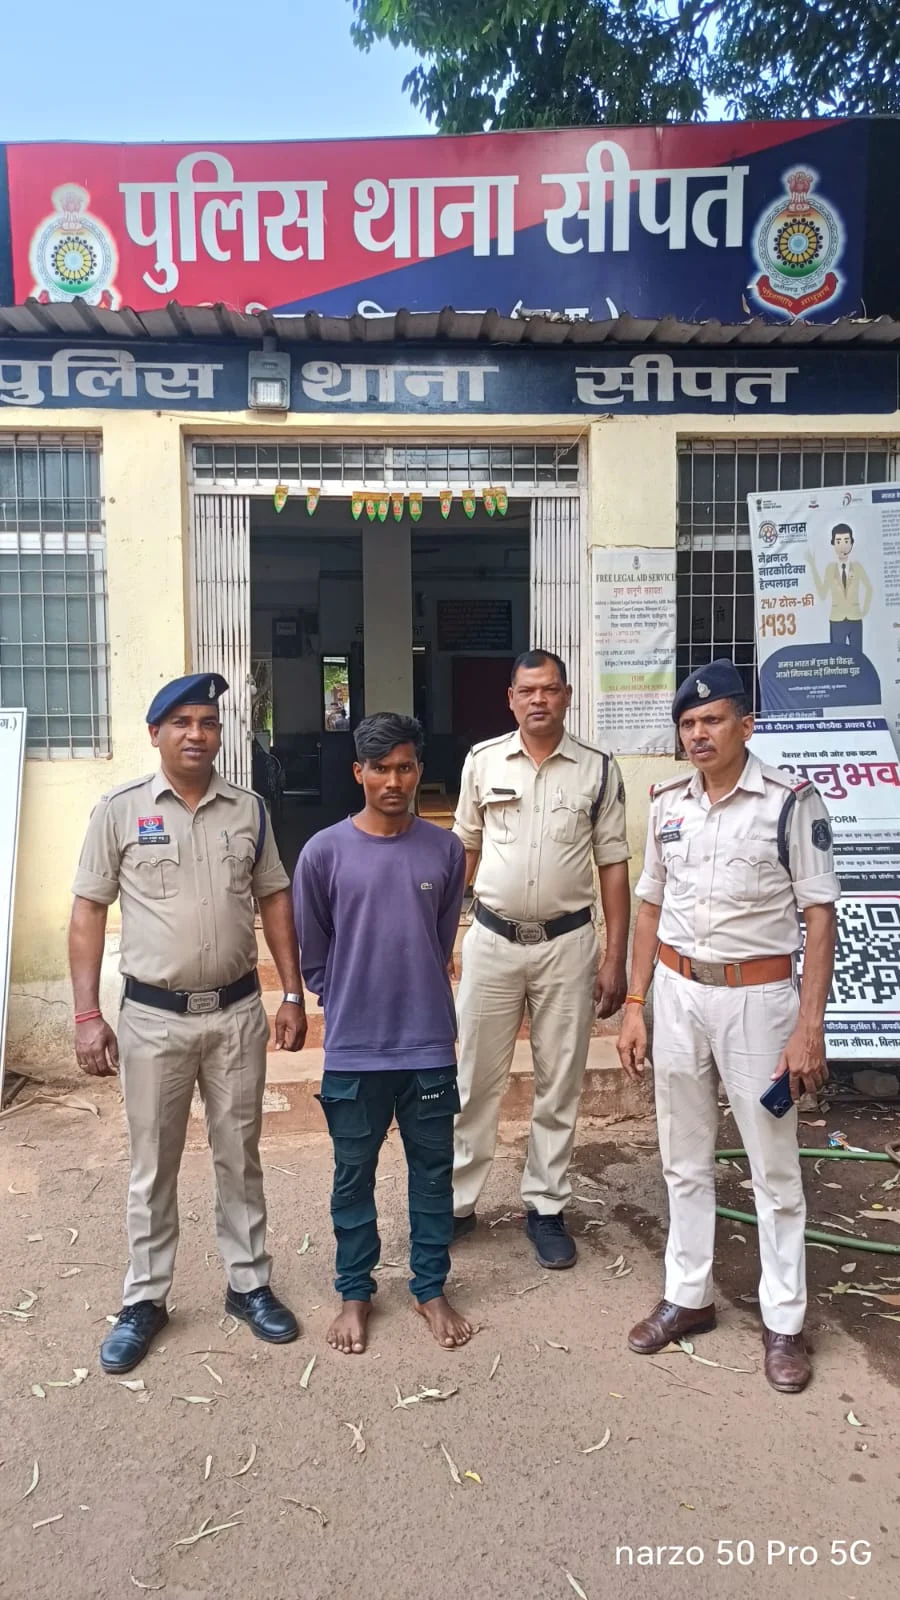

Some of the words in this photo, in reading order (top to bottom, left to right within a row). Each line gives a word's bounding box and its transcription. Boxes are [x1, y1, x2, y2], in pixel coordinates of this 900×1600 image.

[119, 151, 328, 294] पुलिस
[353, 175, 519, 259] थाना
[541, 140, 749, 254] सीपत
[0, 349, 223, 405] पुलिस
[301, 361, 498, 402] थाना
[575, 354, 798, 405] सीपत
[778, 522, 807, 534] मानस
[758, 551, 788, 564] नेशनल
[758, 563, 806, 576] नारकोटिक्स
[595, 573, 612, 583] FREE
[613, 573, 635, 582] LEGAL
[636, 573, 648, 582] AID
[759, 577, 798, 590] हेल्पलाइन
[760, 612, 797, 637] 1933
[828, 1038, 849, 1047] थाना
